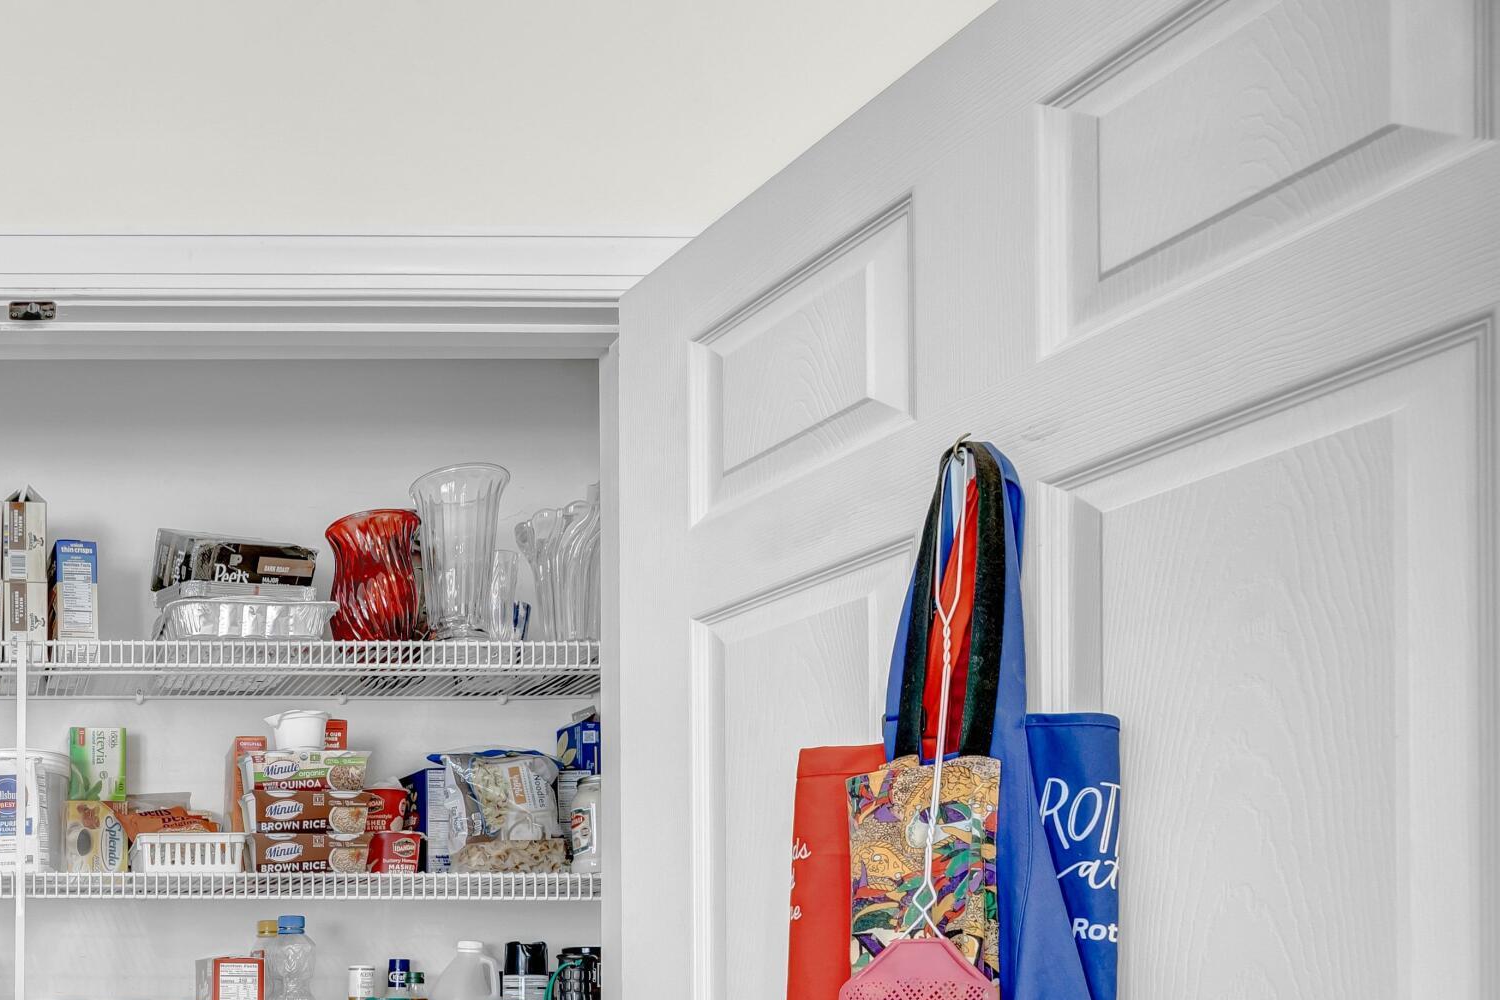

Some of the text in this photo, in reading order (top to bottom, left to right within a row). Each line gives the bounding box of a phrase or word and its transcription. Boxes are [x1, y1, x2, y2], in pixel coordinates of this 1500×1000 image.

[214, 563, 250, 584] Peet's
[264, 565, 290, 574] DARK ROAST
[96, 730, 106, 765] stevia
[264, 762, 300, 775] Minute
[280, 780, 321, 790] QUINOA
[534, 774, 546, 808] Noodles
[266, 804, 303, 817] Minute
[261, 819, 326, 831] BROWN RICE
[105, 815, 122, 867] Splenda
[266, 845, 303, 860] Minute
[261, 861, 326, 873] BROWN RICE
